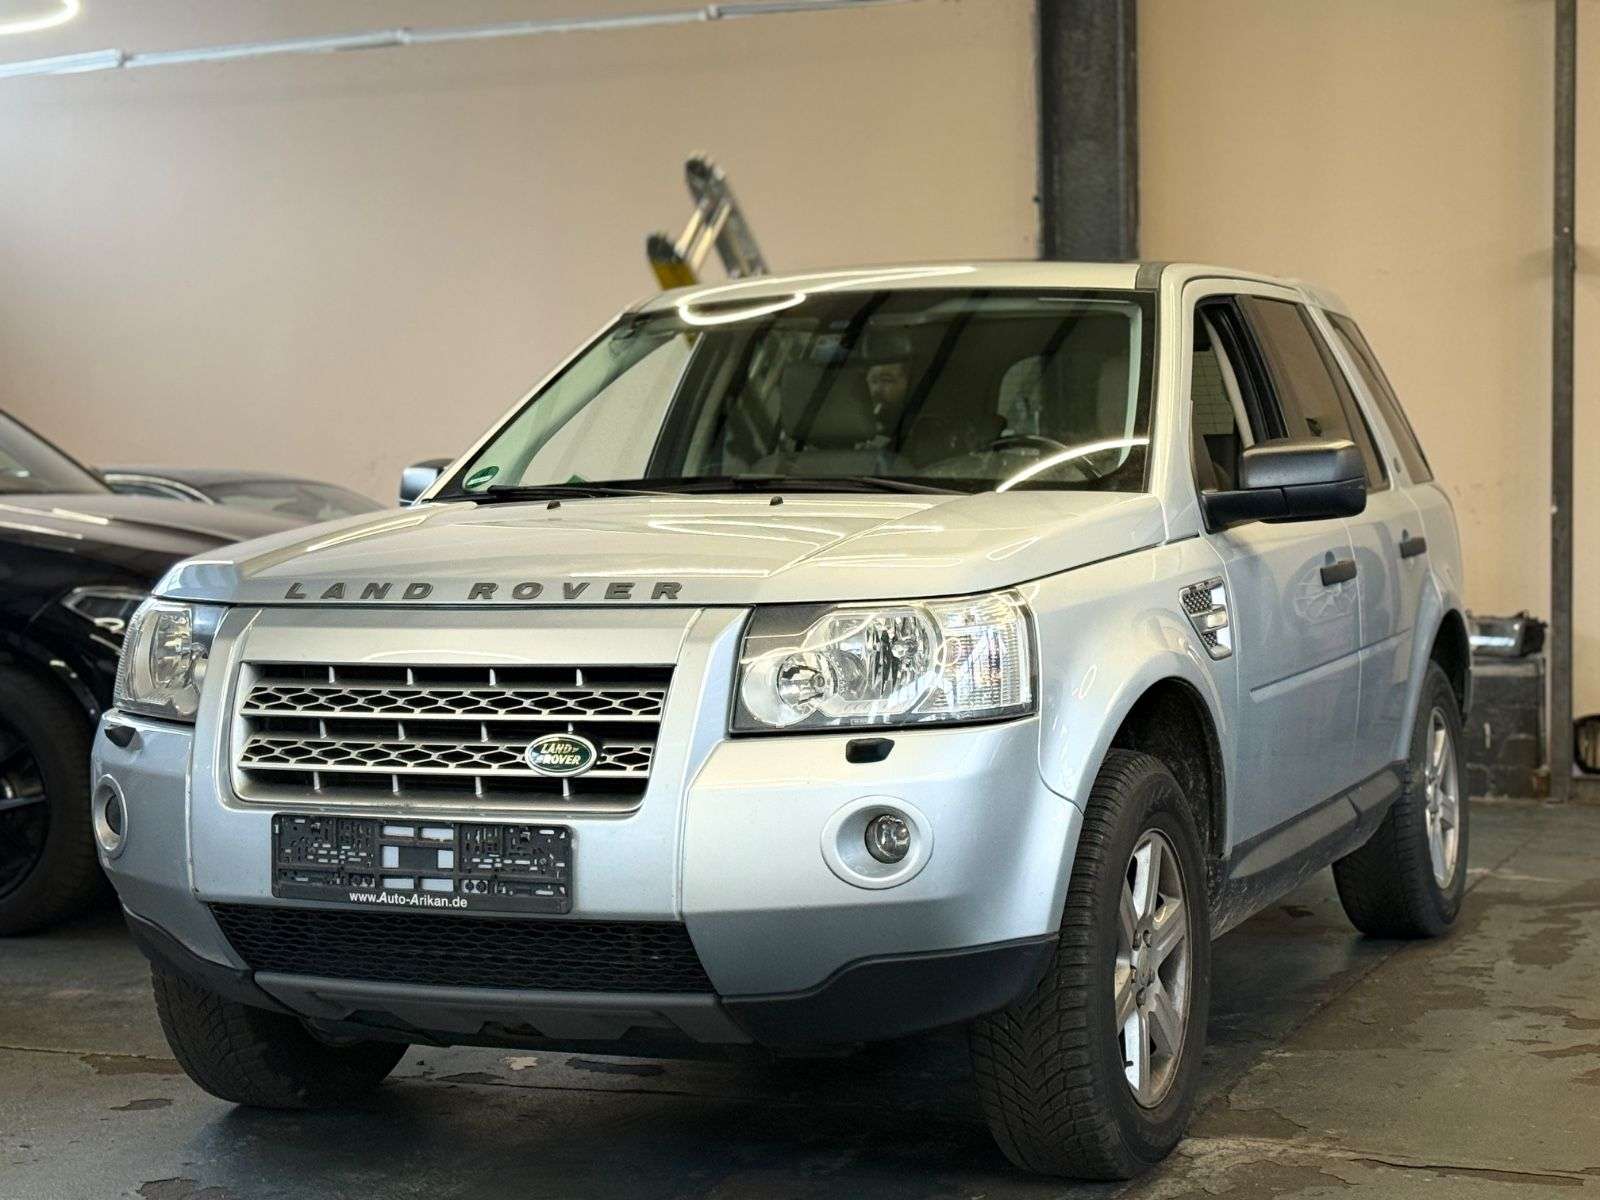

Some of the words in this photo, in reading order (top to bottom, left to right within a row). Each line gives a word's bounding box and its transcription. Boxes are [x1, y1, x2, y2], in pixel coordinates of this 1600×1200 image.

[284, 582, 434, 600] LAND
[467, 582, 683, 600] ROVER
[540, 743, 573, 754] LAND
[542, 754, 582, 765] ROVER
[349, 891, 468, 908] www.Auto-Arikan.de
